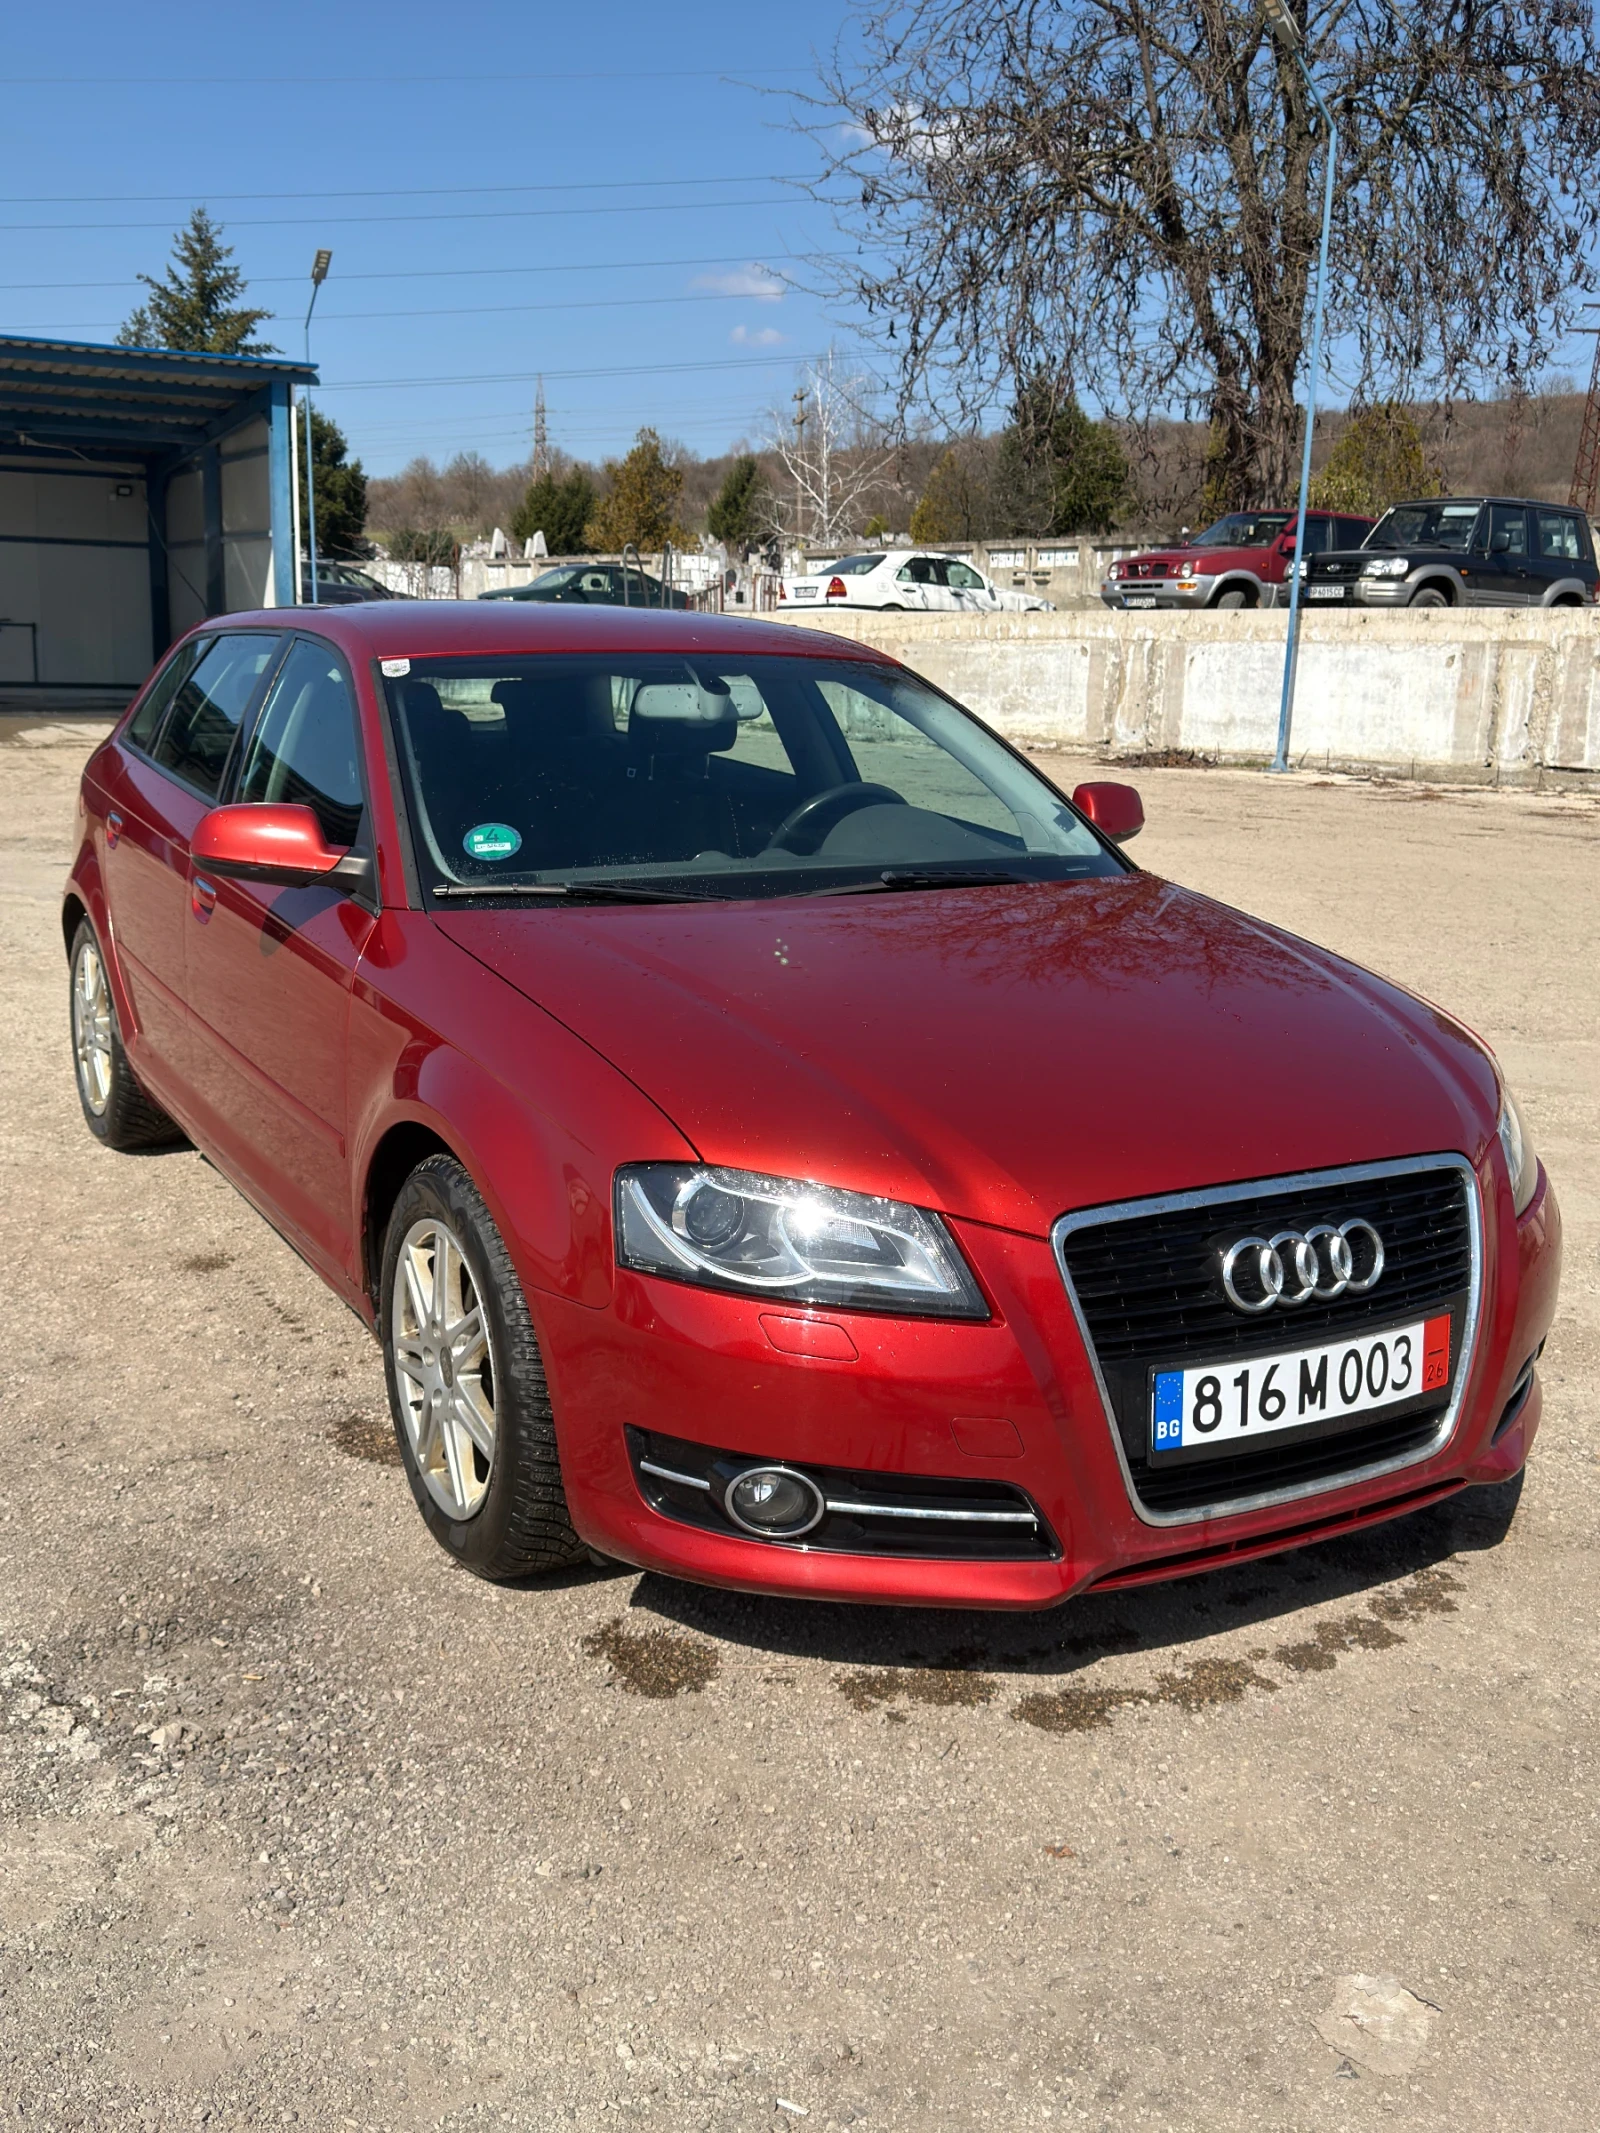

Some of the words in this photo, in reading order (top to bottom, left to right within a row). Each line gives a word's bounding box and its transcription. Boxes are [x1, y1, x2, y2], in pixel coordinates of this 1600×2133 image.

[485, 828, 500, 842] 4
[1426, 1363, 1444, 1383] 26
[1192, 1363, 1286, 1433] 816
[1298, 1355, 1328, 1415] M
[1339, 1335, 1412, 1405] 003
[1156, 1418, 1180, 1440] BG
